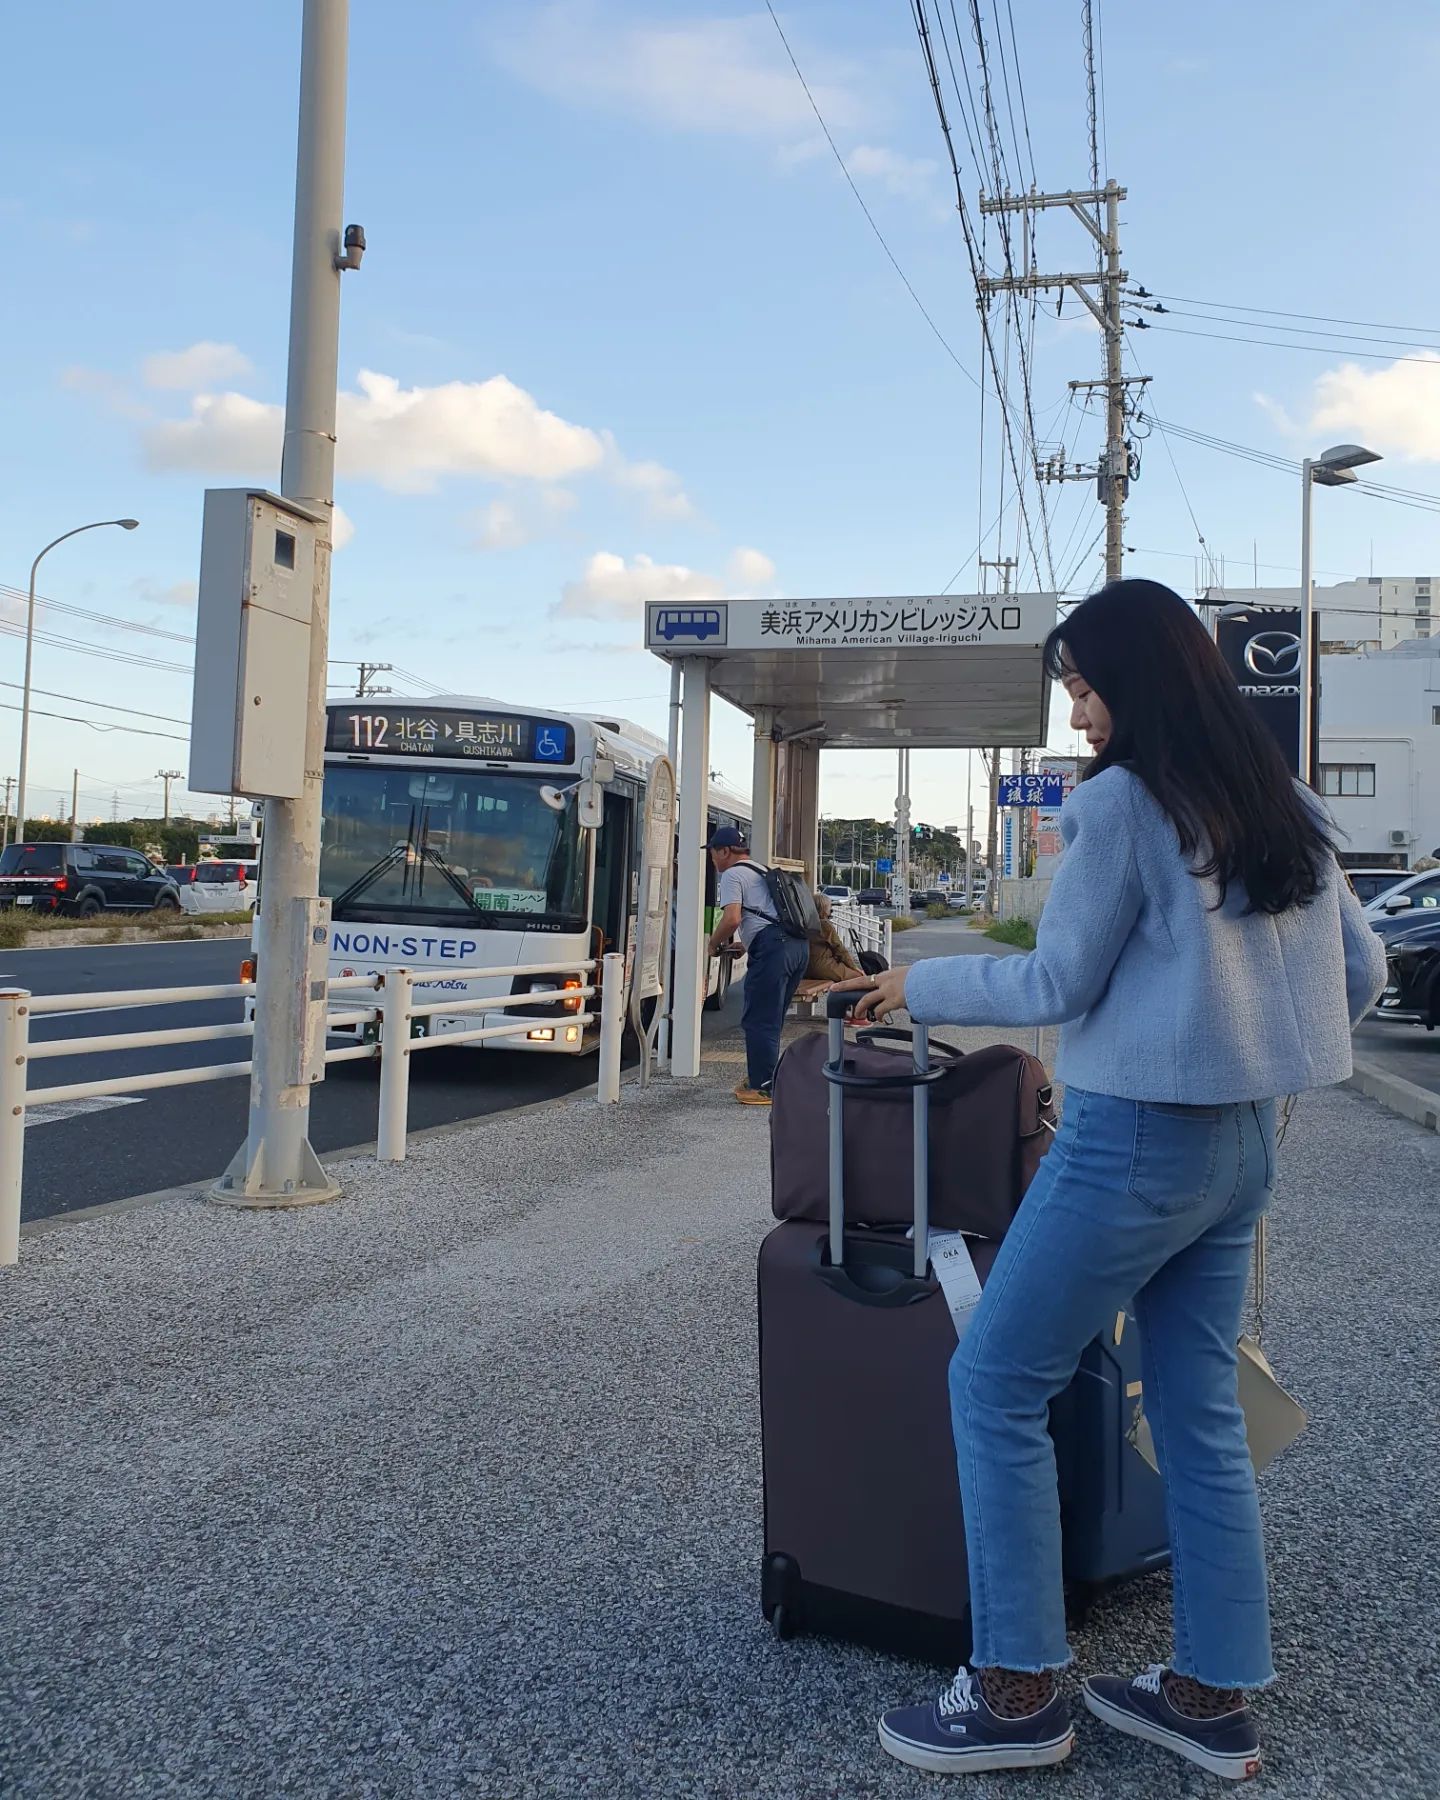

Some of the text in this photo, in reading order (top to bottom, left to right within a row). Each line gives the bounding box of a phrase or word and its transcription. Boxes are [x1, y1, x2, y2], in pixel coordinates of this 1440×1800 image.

[761, 606, 1020, 635] 美浜アメリカンビレッジ入口
[796, 633, 981, 645] Mihama American Village-Iriguchi
[1238, 685, 1300, 696] mazd
[349, 714, 389, 748] 112
[395, 717, 521, 745] 北谷 具志川
[400, 742, 513, 757] CHATAN GUSHIKAWA
[1003, 776, 1060, 787] K-1 GYM
[1006, 787, 1045, 804] 琉球
[527, 923, 561, 931] HINO
[333, 932, 477, 959] NON-STEP
[943, 1249, 959, 1259] OKA
